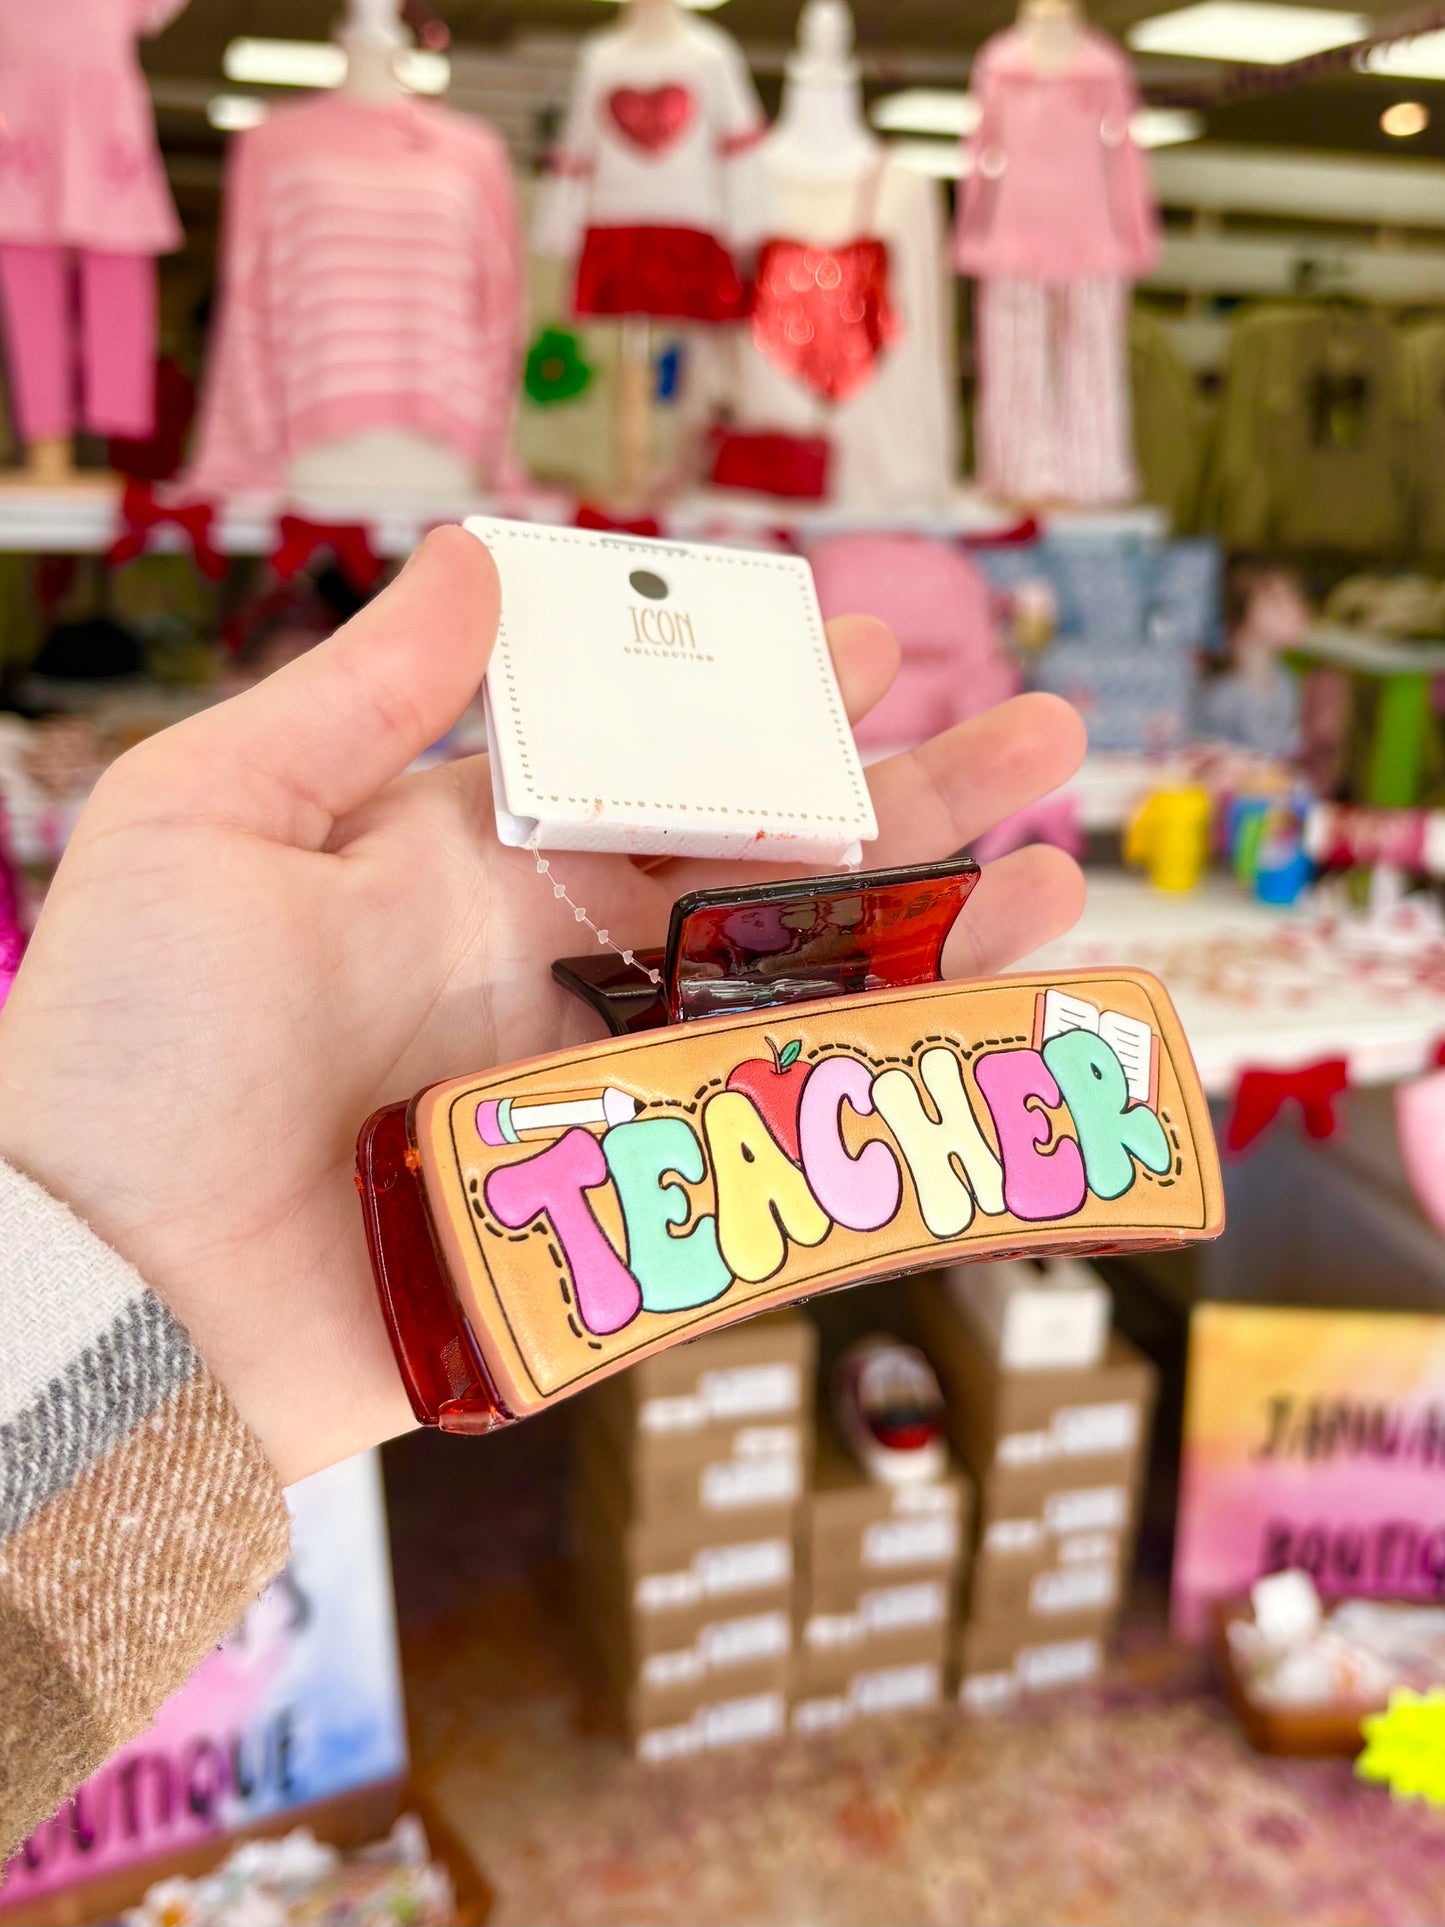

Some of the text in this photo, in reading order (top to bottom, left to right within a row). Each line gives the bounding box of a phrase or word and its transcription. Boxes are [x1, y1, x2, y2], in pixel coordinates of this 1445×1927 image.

[629, 606, 696, 649] ICON
[623, 646, 714, 662] COLLECTION
[485, 1029, 1172, 1336] TEACHER
